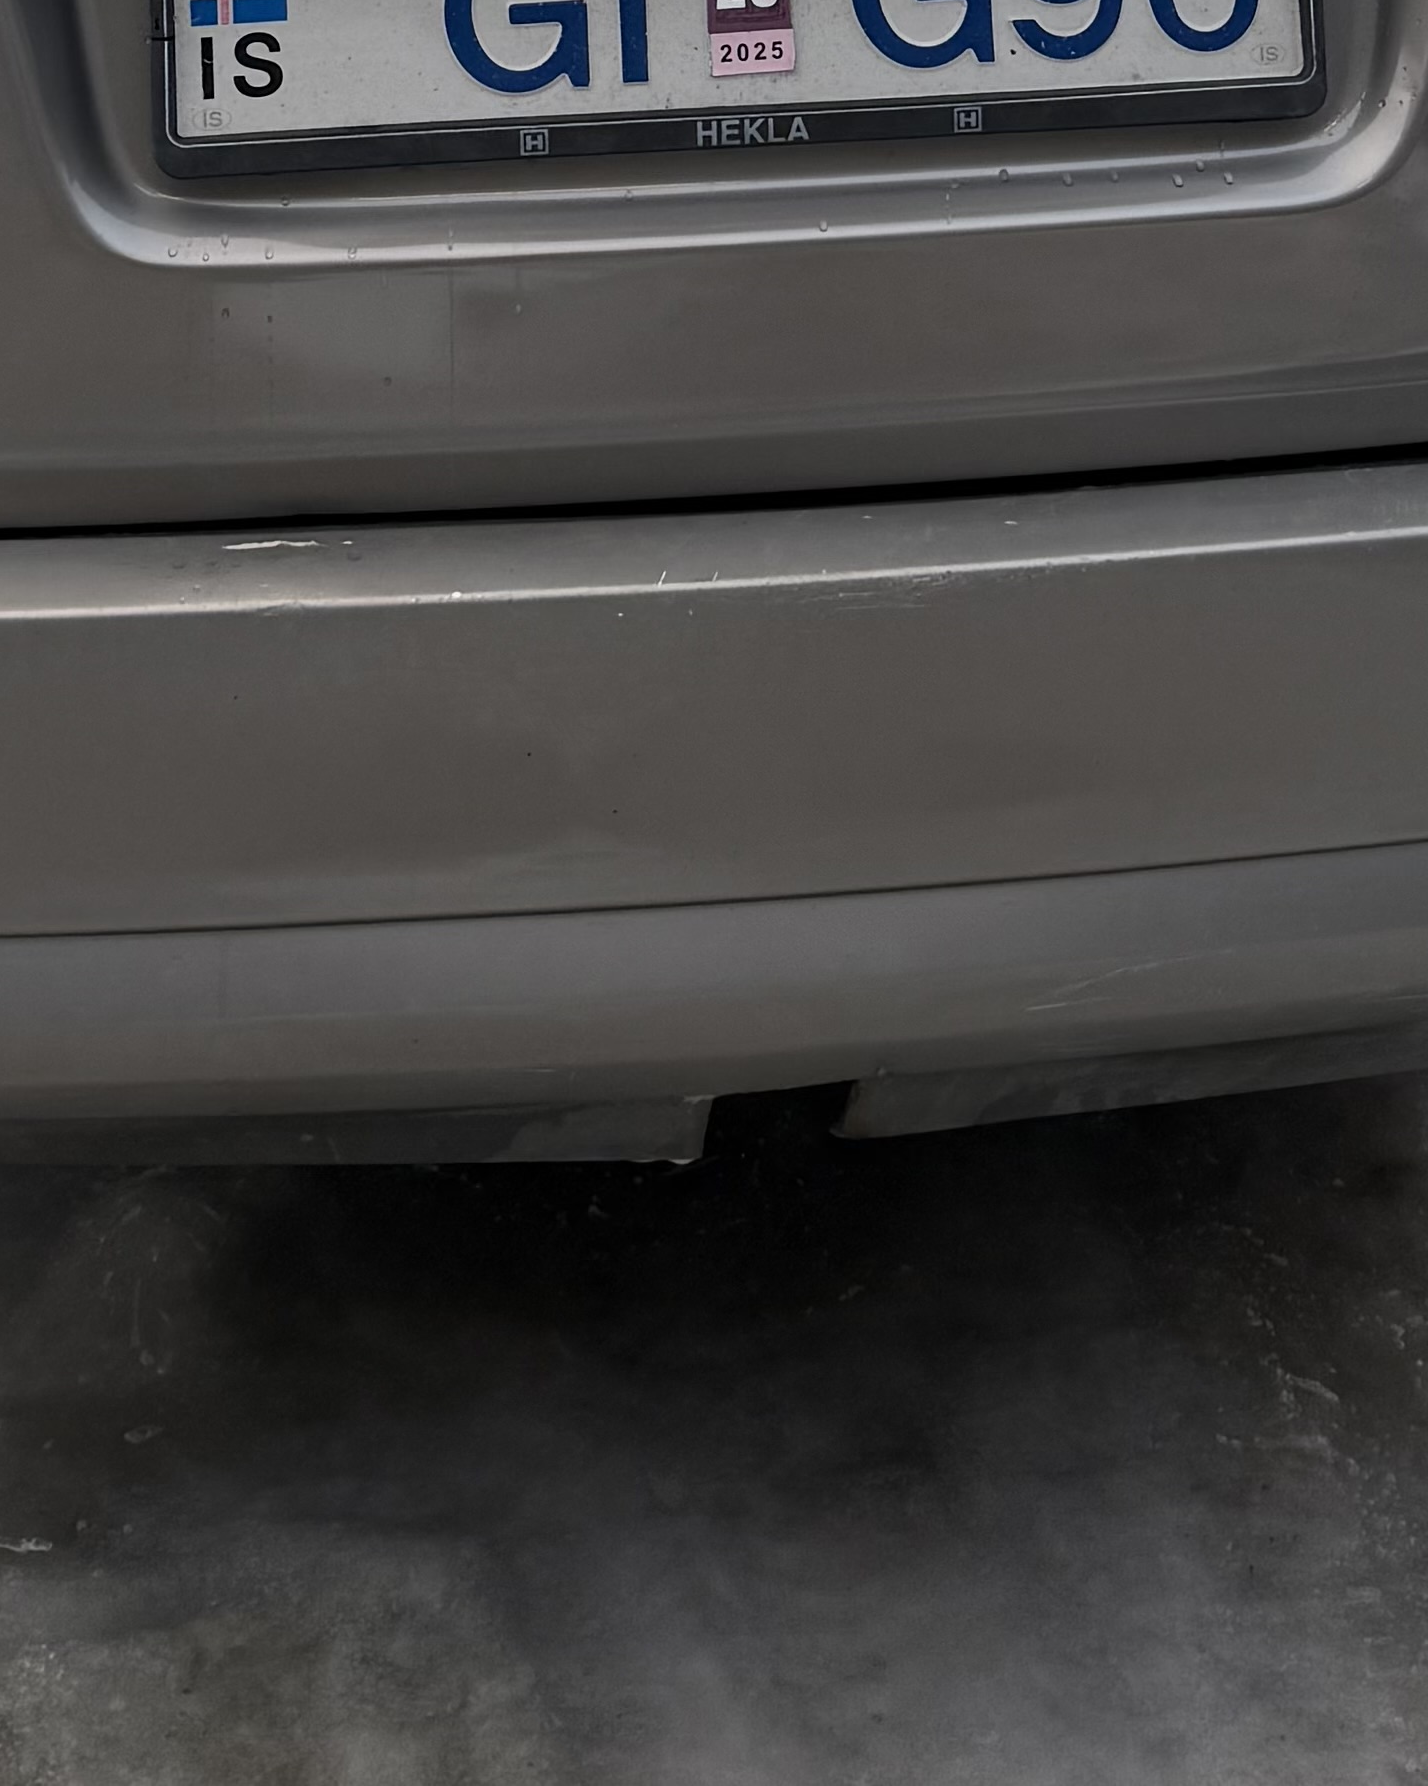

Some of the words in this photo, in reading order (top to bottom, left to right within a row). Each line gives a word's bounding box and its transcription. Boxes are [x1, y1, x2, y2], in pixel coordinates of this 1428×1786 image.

[720, 40, 784, 64] 2025
[1259, 46, 1279, 62] IS
[201, 32, 284, 101] IS
[202, 111, 223, 128] IS
[957, 109, 979, 130] H
[523, 131, 546, 153] H
[696, 116, 810, 147] HEKLA
